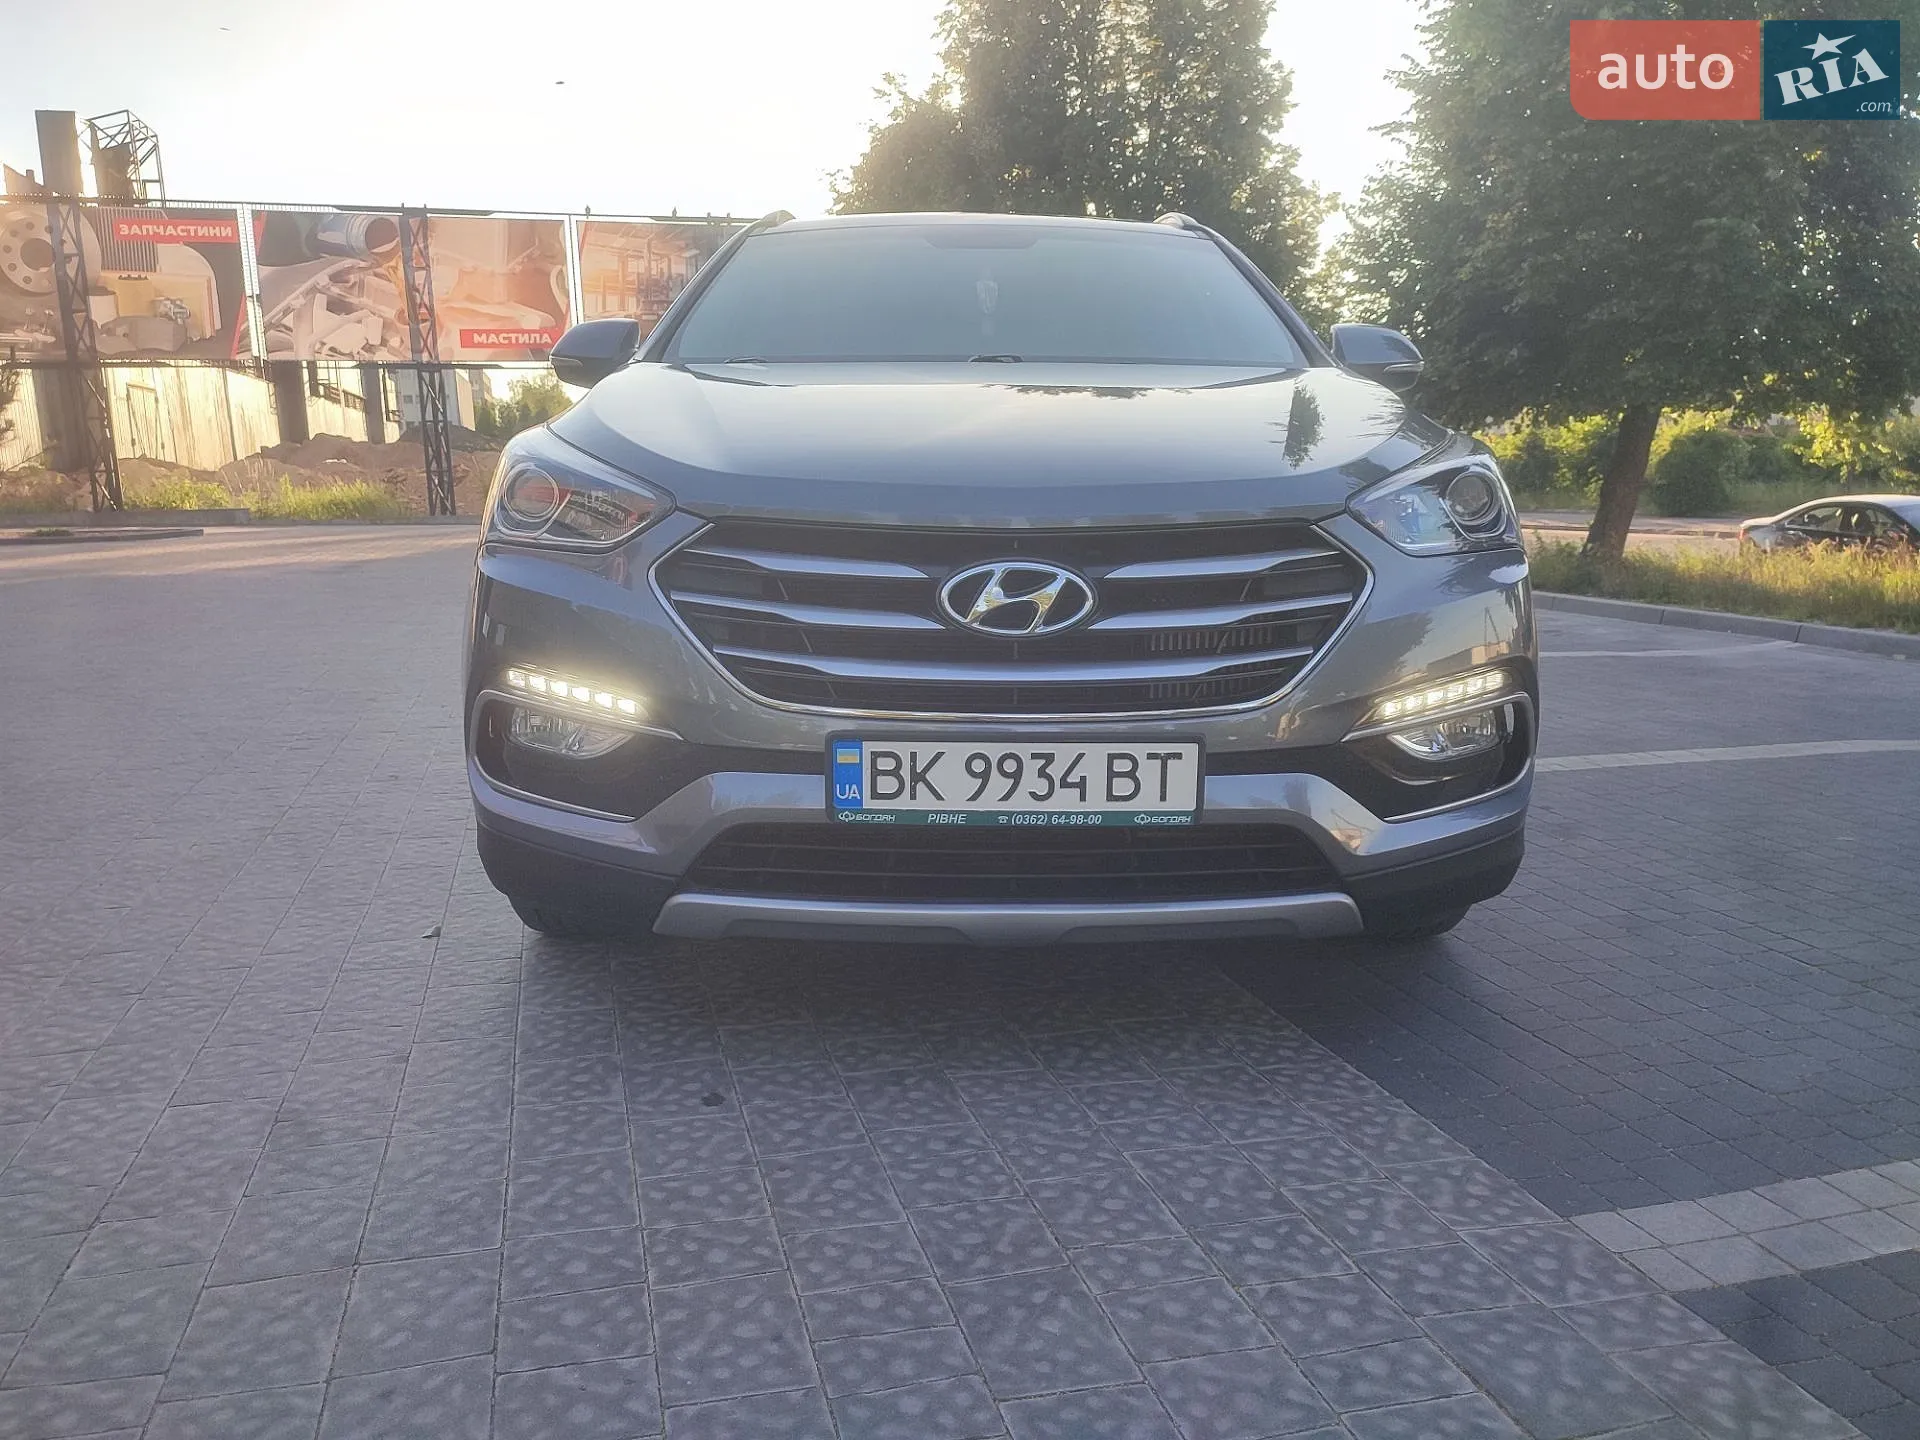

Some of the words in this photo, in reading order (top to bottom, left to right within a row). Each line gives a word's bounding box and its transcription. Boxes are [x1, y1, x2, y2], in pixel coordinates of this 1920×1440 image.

[119, 224, 232, 237] ЗАПЧАСТИНИ
[473, 333, 552, 344] МАСТИЛА
[870, 751, 946, 801] BK
[964, 751, 1088, 803] 9934
[1106, 753, 1182, 802] BT
[836, 783, 860, 800] UA
[855, 813, 895, 822] БОГДАН
[927, 813, 967, 824] РІВНЕ
[1011, 813, 1048, 825] (0362)
[1051, 813, 1102, 825] 64-98-00
[1151, 815, 1191, 823] БОГДАН
